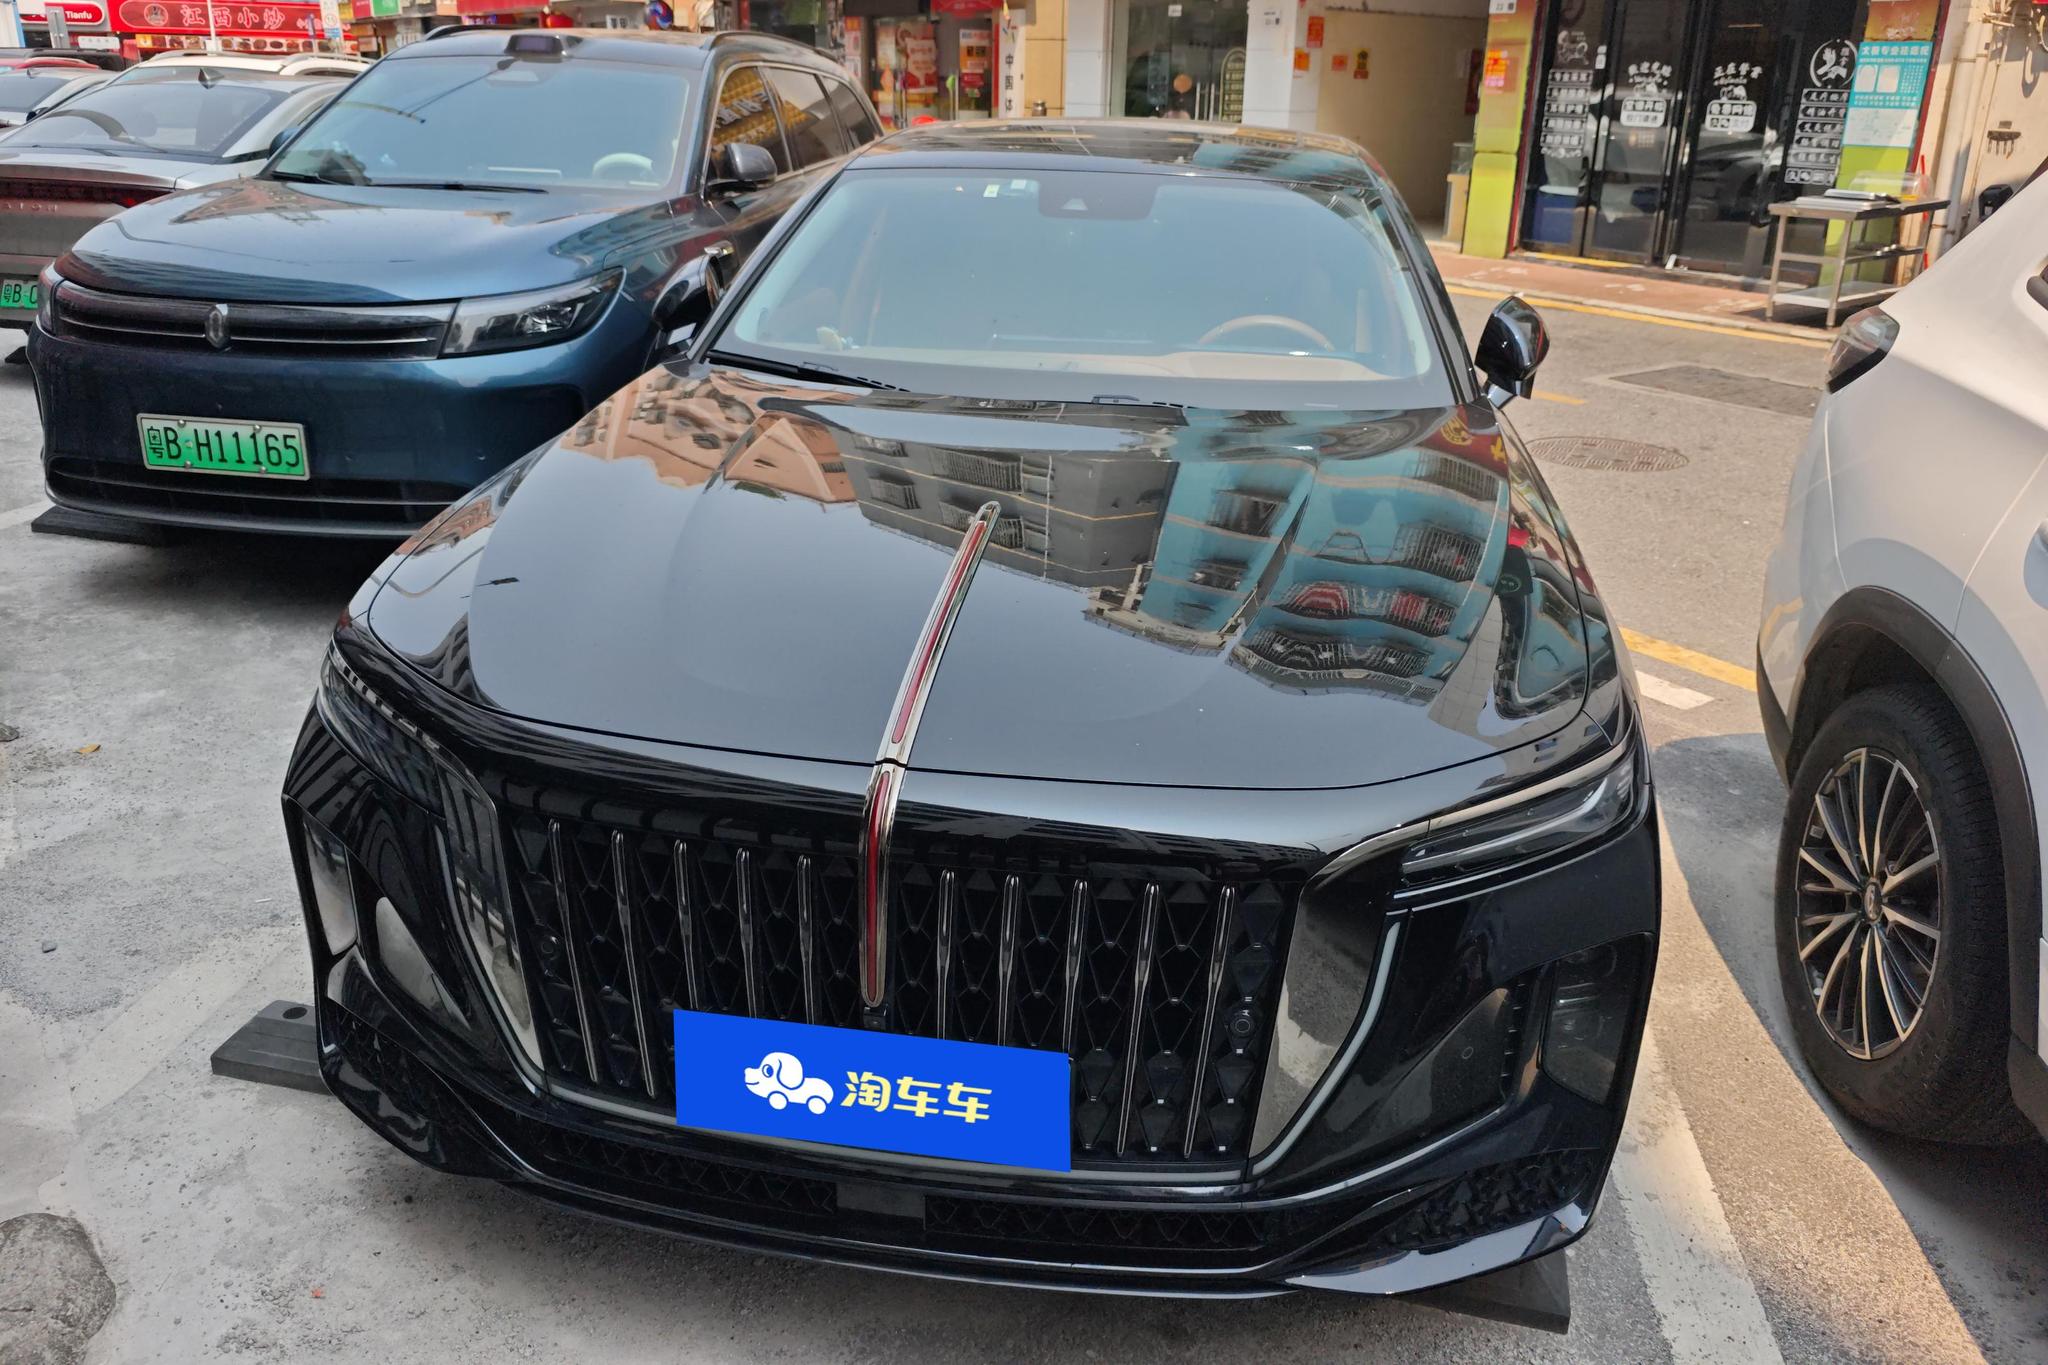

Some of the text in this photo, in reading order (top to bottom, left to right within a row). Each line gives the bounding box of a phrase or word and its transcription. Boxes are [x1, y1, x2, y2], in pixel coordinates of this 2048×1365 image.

[65, 10, 92, 20] Tianfu
[180, 4, 285, 30] 江西小炒
